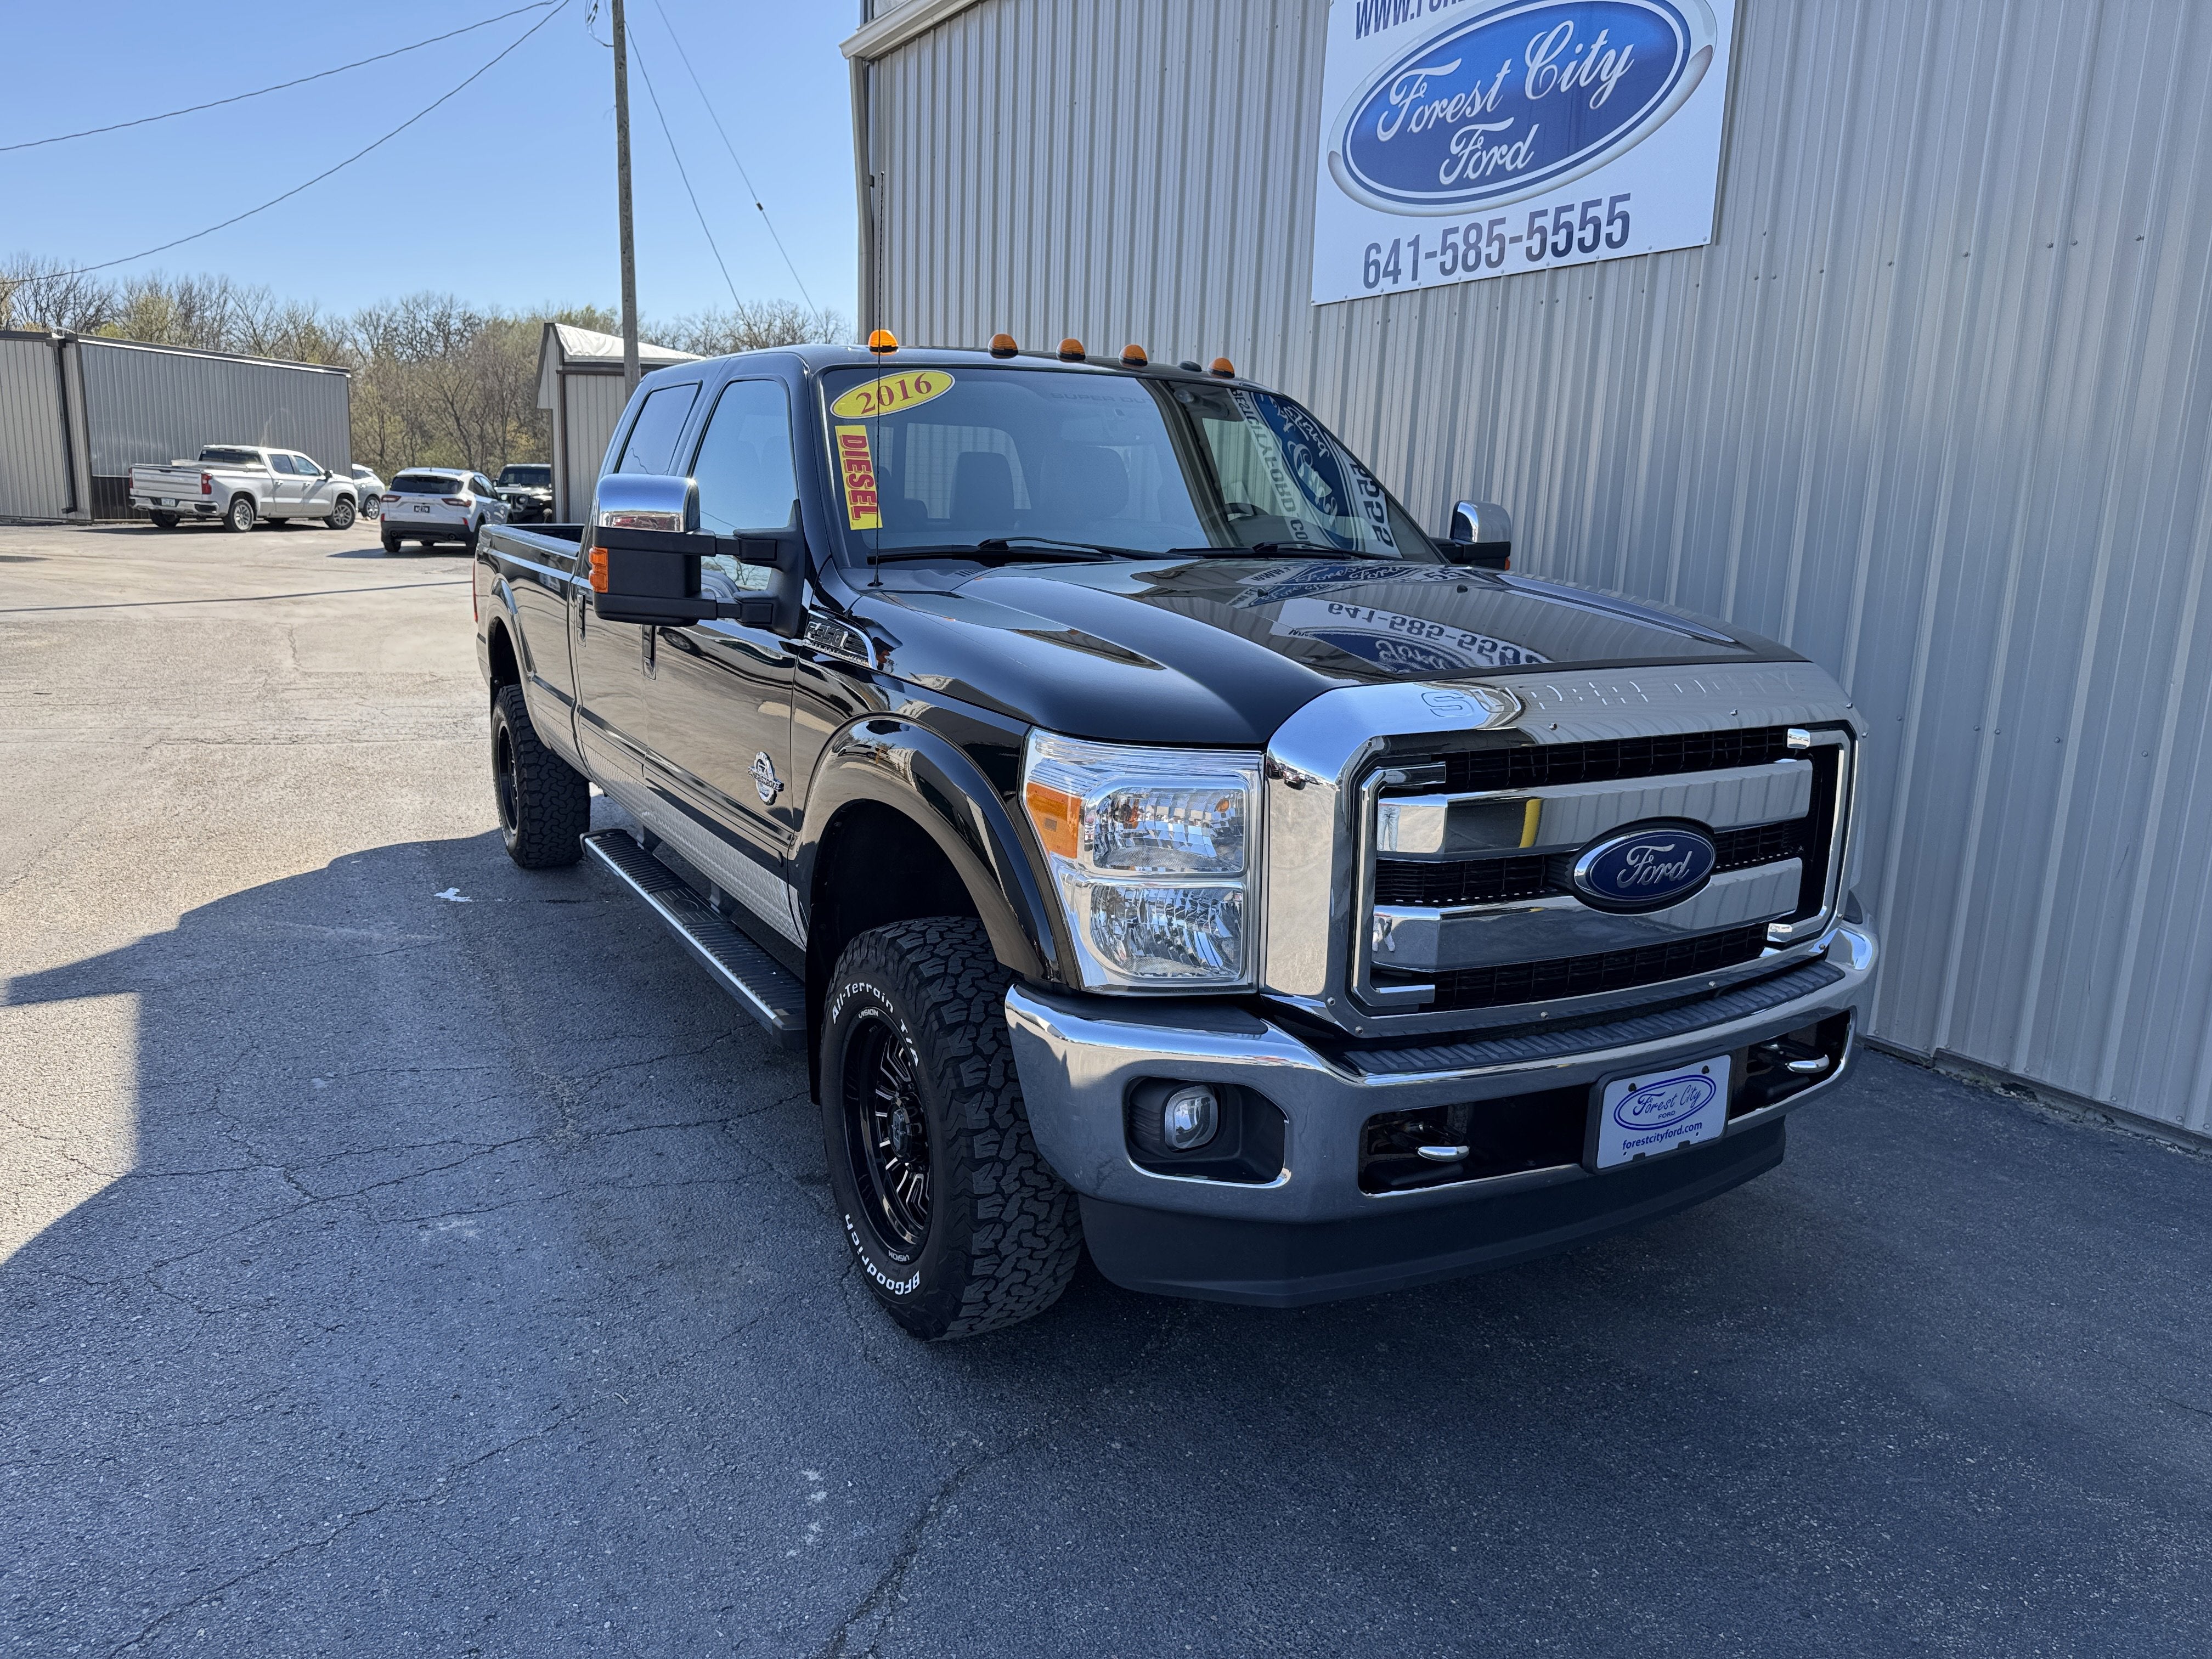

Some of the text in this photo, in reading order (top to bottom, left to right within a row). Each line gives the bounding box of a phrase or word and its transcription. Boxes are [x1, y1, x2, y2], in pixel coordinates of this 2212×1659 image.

[1376, 20, 1634, 142] Forest City
[1440, 116, 1539, 185] Ford
[1363, 193, 1631, 289] 641-585-5555
[856, 373, 932, 415] 2016
[839, 434, 878, 521] DIESEL
[1617, 843, 1692, 888] Ford
[832, 982, 894, 1025] All-Terrain
[858, 1008, 878, 1019] VISION
[1633, 1084, 1701, 1115] Forest City
[1658, 1110, 1675, 1119] FORD
[1622, 1121, 1702, 1150] forestcityford.com
[845, 1214, 920, 1295] BFGoodrich
[888, 1250, 910, 1262] VISION
